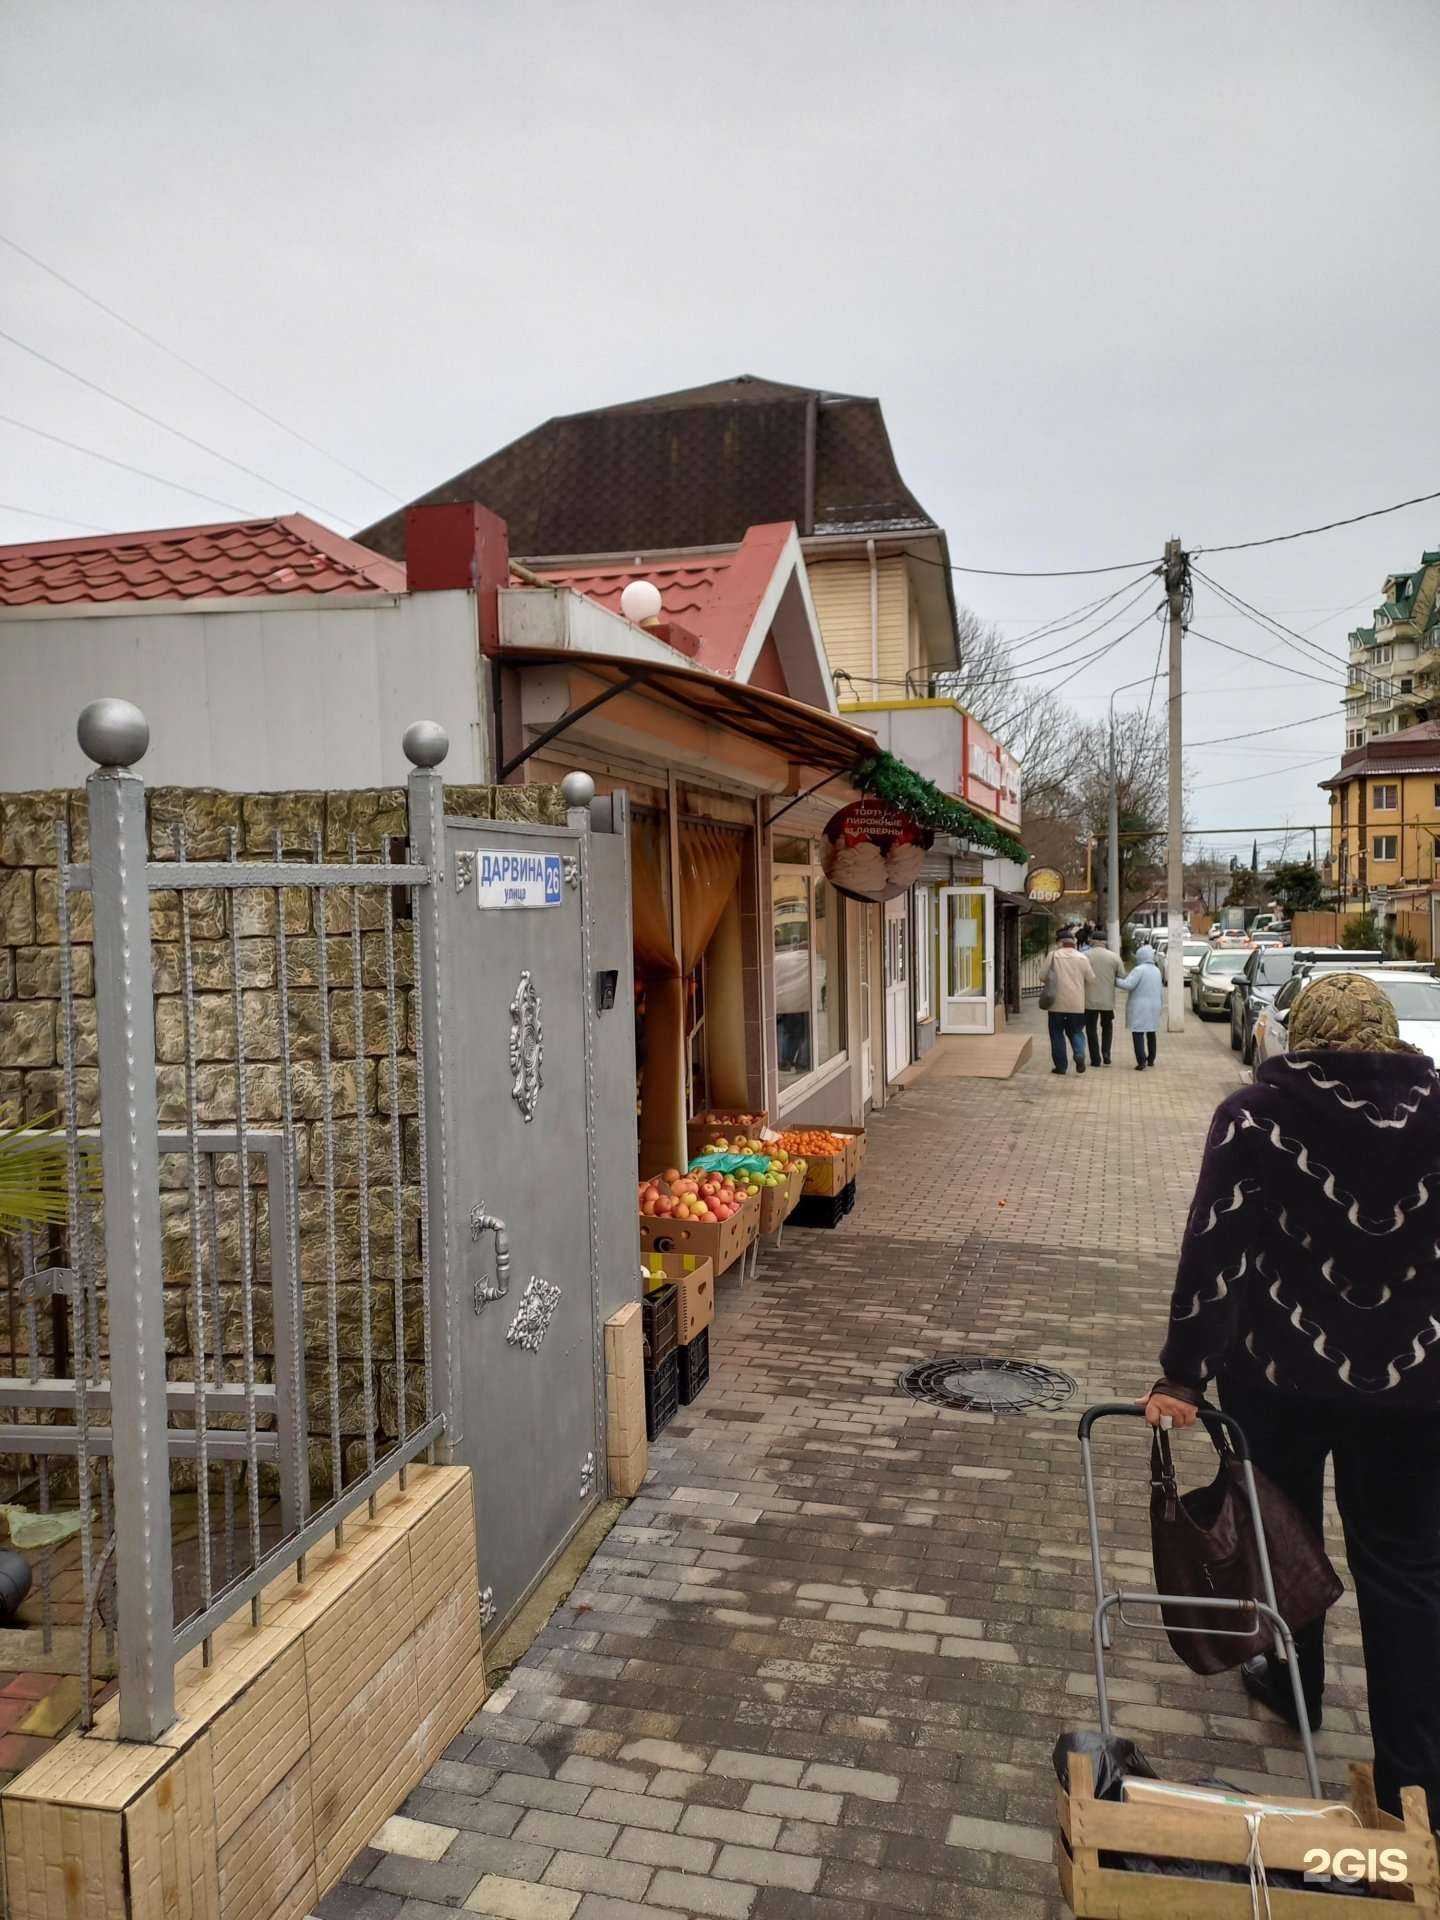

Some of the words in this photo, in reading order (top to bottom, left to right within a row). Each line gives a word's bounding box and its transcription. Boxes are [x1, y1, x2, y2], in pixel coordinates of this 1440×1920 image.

[481, 855, 543, 887] ДАРВИНА
[546, 867, 560, 895] 26
[504, 887, 526, 904] улица
[1029, 883, 1061, 902] ДВОР
